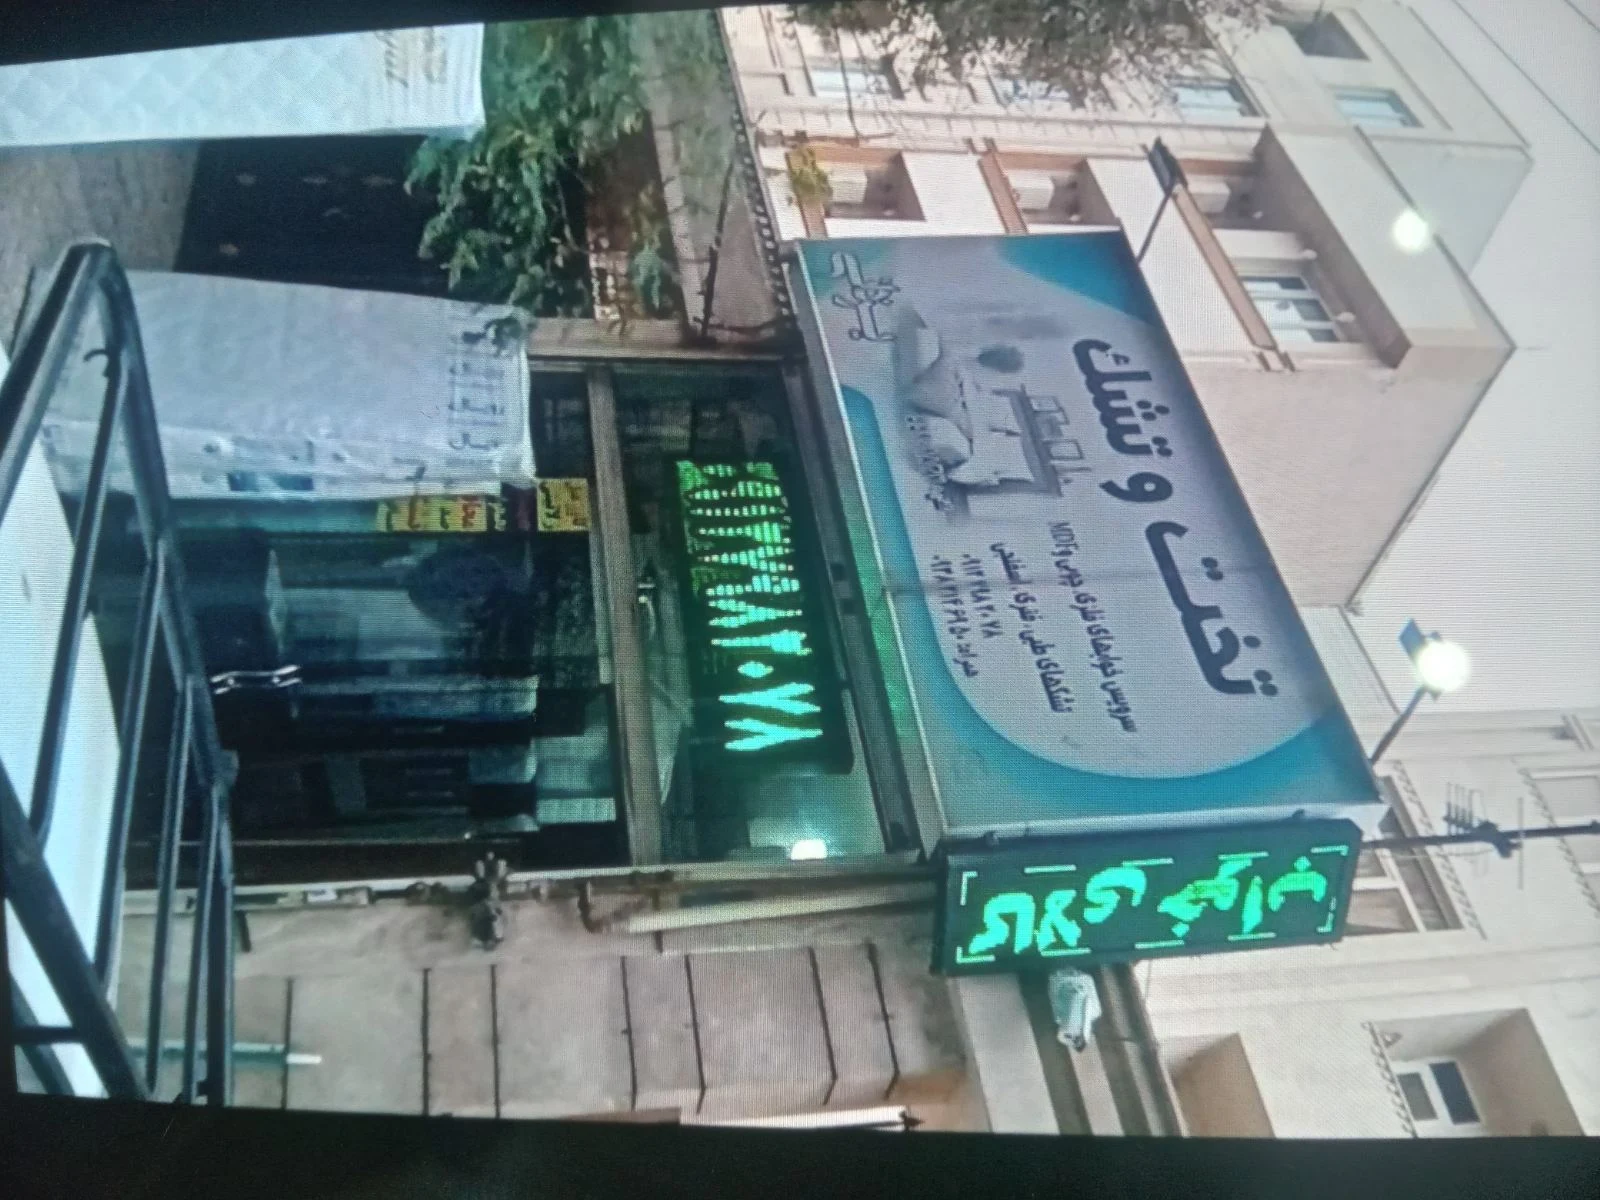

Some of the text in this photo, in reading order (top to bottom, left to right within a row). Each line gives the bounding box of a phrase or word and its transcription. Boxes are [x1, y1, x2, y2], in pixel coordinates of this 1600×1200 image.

[1099, 471, 1174, 503] و
[1145, 521, 1279, 697] تخت
[1100, 681, 1138, 733] سرویس
